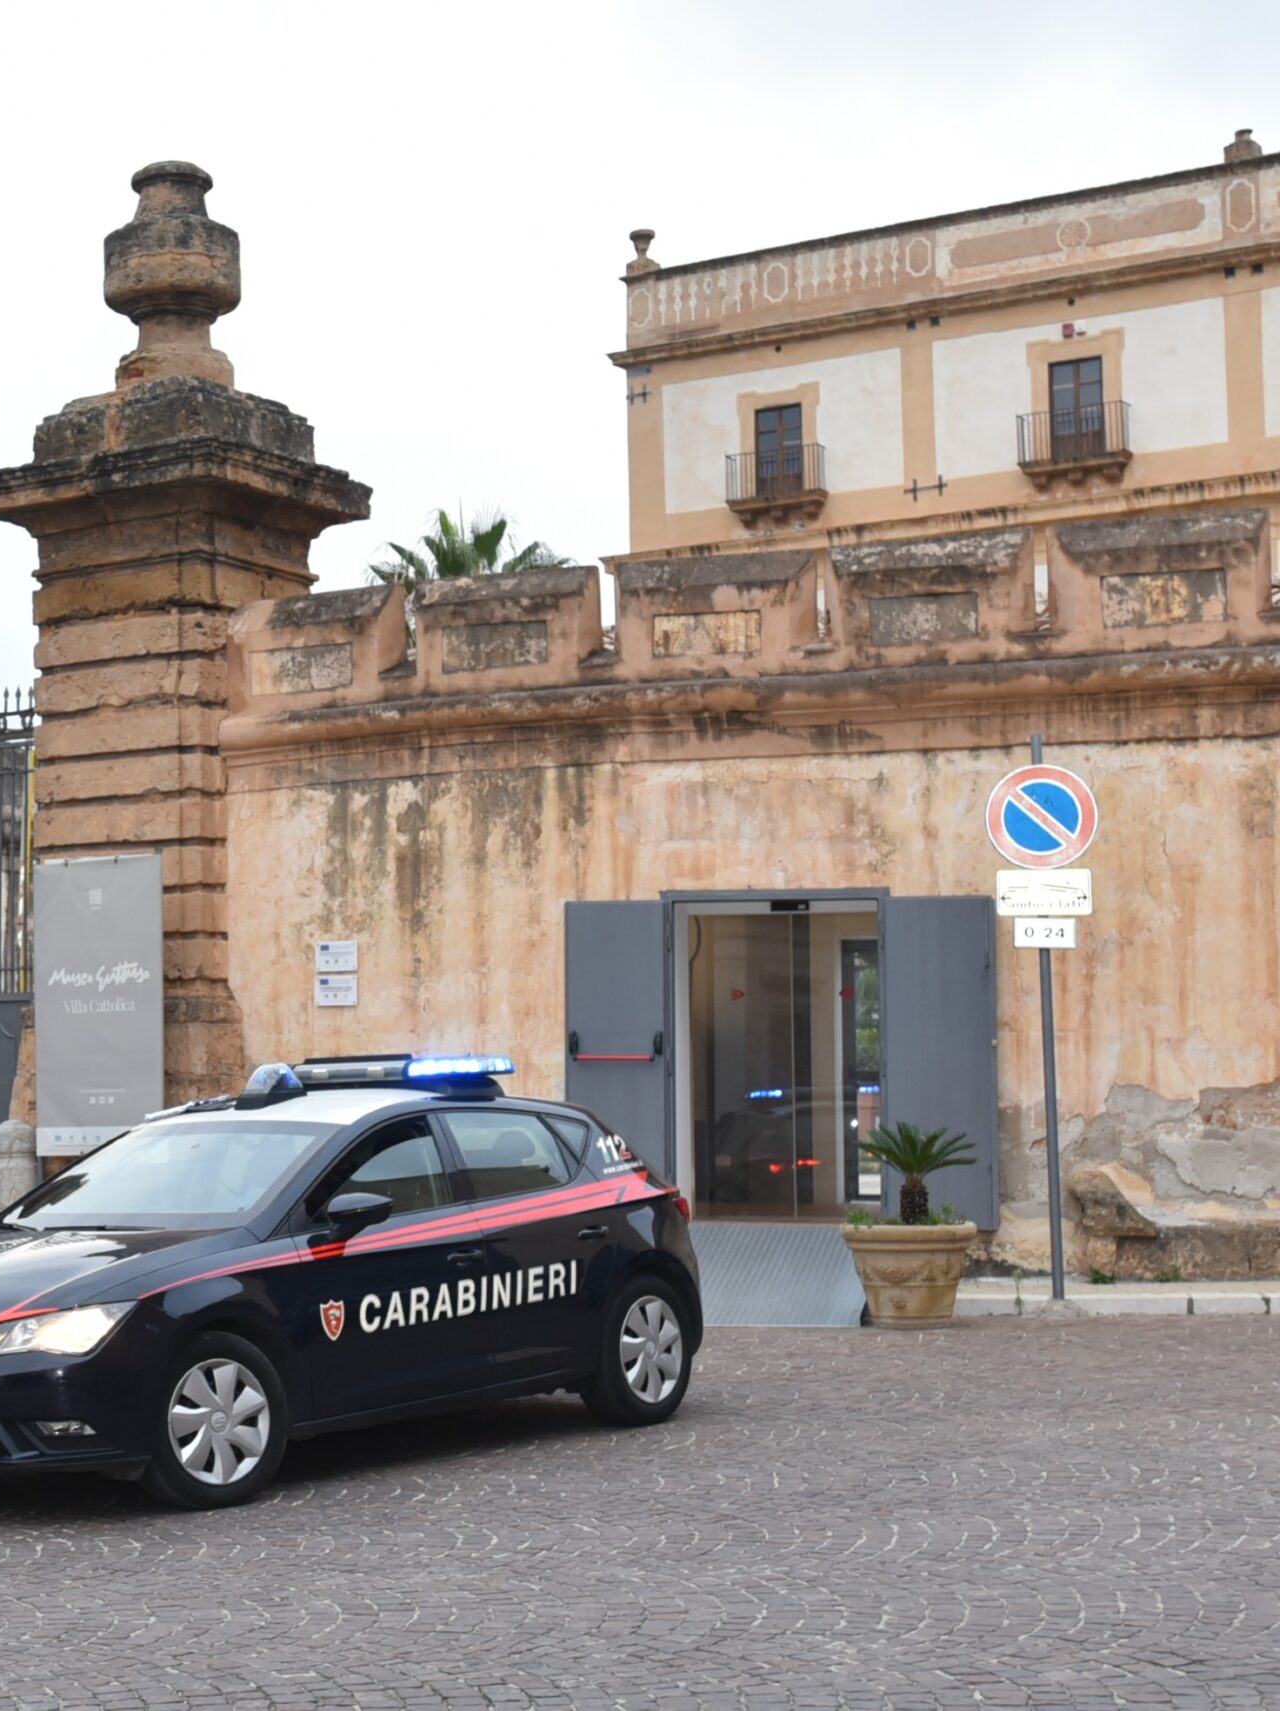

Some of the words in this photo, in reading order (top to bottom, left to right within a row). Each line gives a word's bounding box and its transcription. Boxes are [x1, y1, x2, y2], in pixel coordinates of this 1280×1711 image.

[48, 967, 94, 986] Museo
[64, 1000, 88, 1013] Villa
[596, 1133, 632, 1164] 112
[358, 1260, 577, 1333] CARABINIERI
